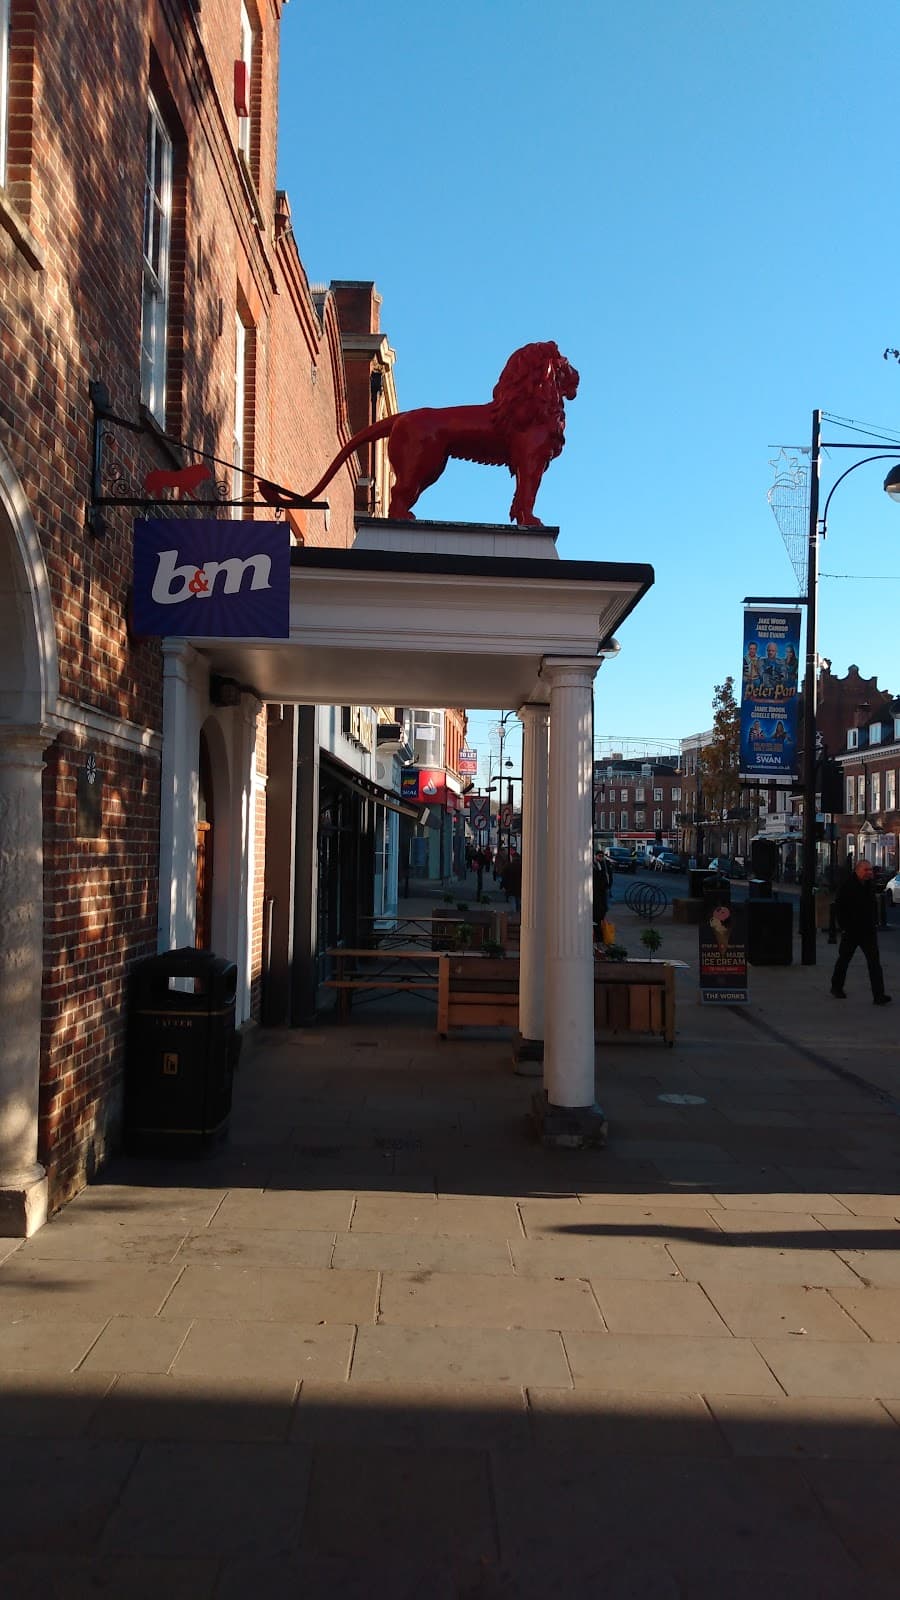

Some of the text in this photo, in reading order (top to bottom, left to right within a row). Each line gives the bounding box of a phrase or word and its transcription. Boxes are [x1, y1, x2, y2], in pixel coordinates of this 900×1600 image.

[744, 683, 796, 700] Peter Pan
[756, 756, 782, 764] SWAN
[702, 958, 746, 966] ICE CREAM
